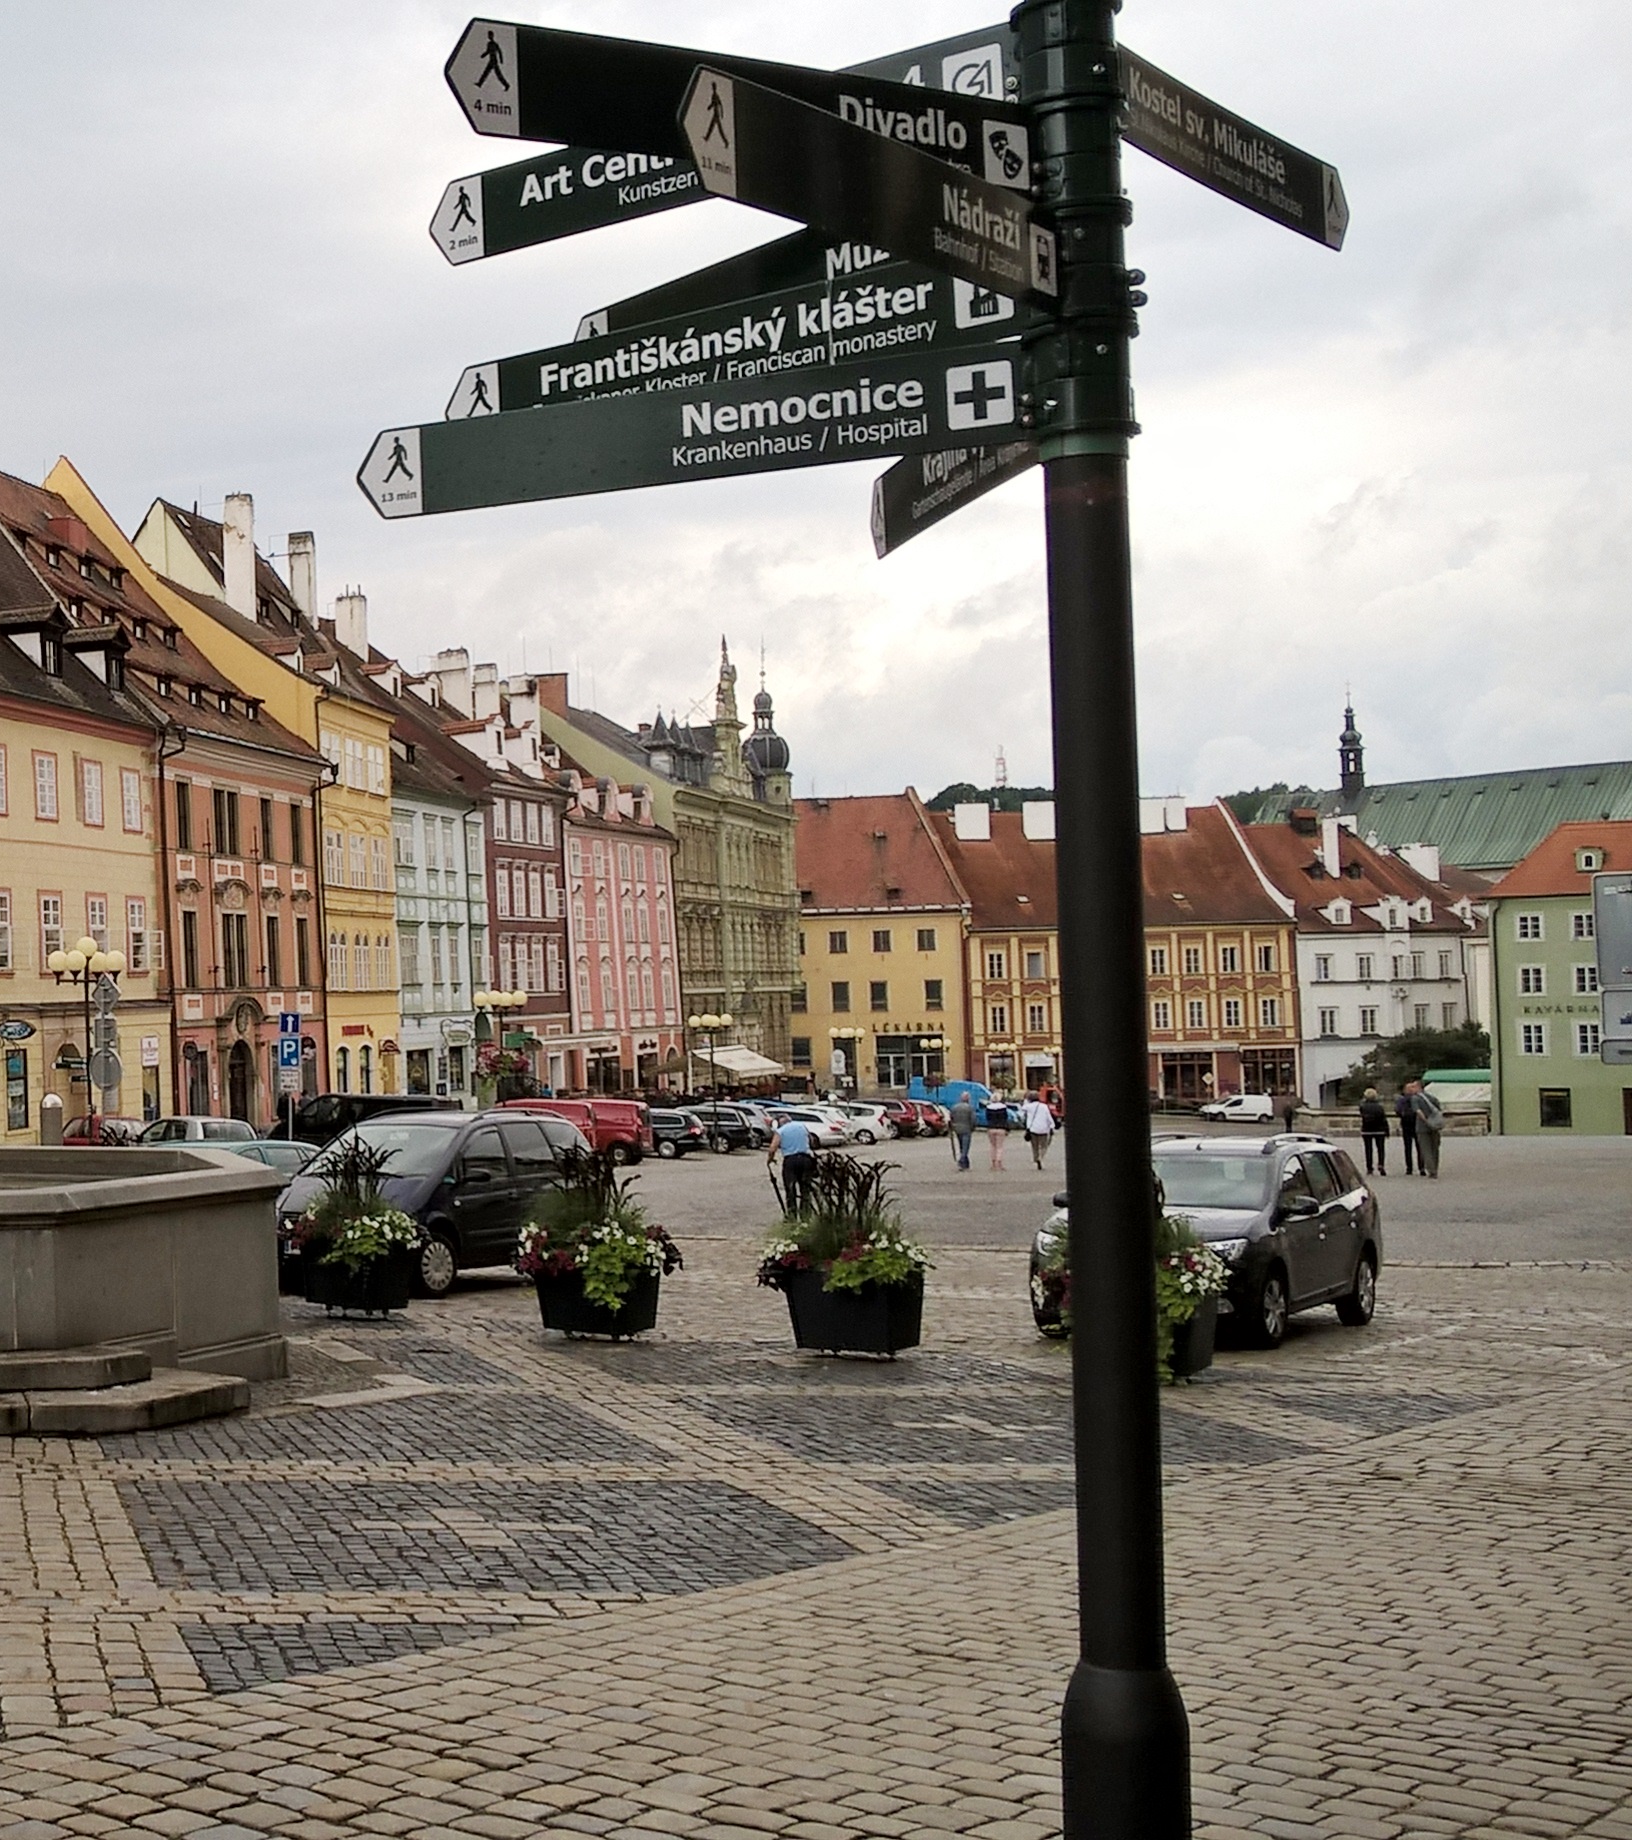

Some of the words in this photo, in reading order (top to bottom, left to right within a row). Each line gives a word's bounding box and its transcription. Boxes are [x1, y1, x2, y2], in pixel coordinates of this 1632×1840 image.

[474, 99, 482, 111] 4
[487, 102, 512, 116] min
[839, 94, 967, 150] Divadlo
[1129, 66, 1181, 127] Kostel
[1185, 110, 1209, 143] sv.
[1213, 119, 1286, 184] Mikuláše
[519, 165, 574, 207] Art
[618, 171, 699, 205] Kunstzen
[943, 183, 1020, 250] Nádraží
[449, 240, 456, 250] 2
[458, 235, 478, 248] min
[934, 227, 979, 264] Bahnhof
[540, 307, 786, 396] Františkánský
[798, 282, 934, 338] klášter
[713, 364, 721, 383] /
[726, 345, 826, 381] Franciscan
[832, 320, 937, 358] monastery
[682, 378, 924, 438] Nemocnice
[672, 432, 813, 467] Krankenhaus
[819, 427, 829, 452] /
[838, 413, 928, 446] Hospital
[381, 492, 394, 503] 13
[397, 490, 417, 501] min
[283, 1041, 296, 1059] P
